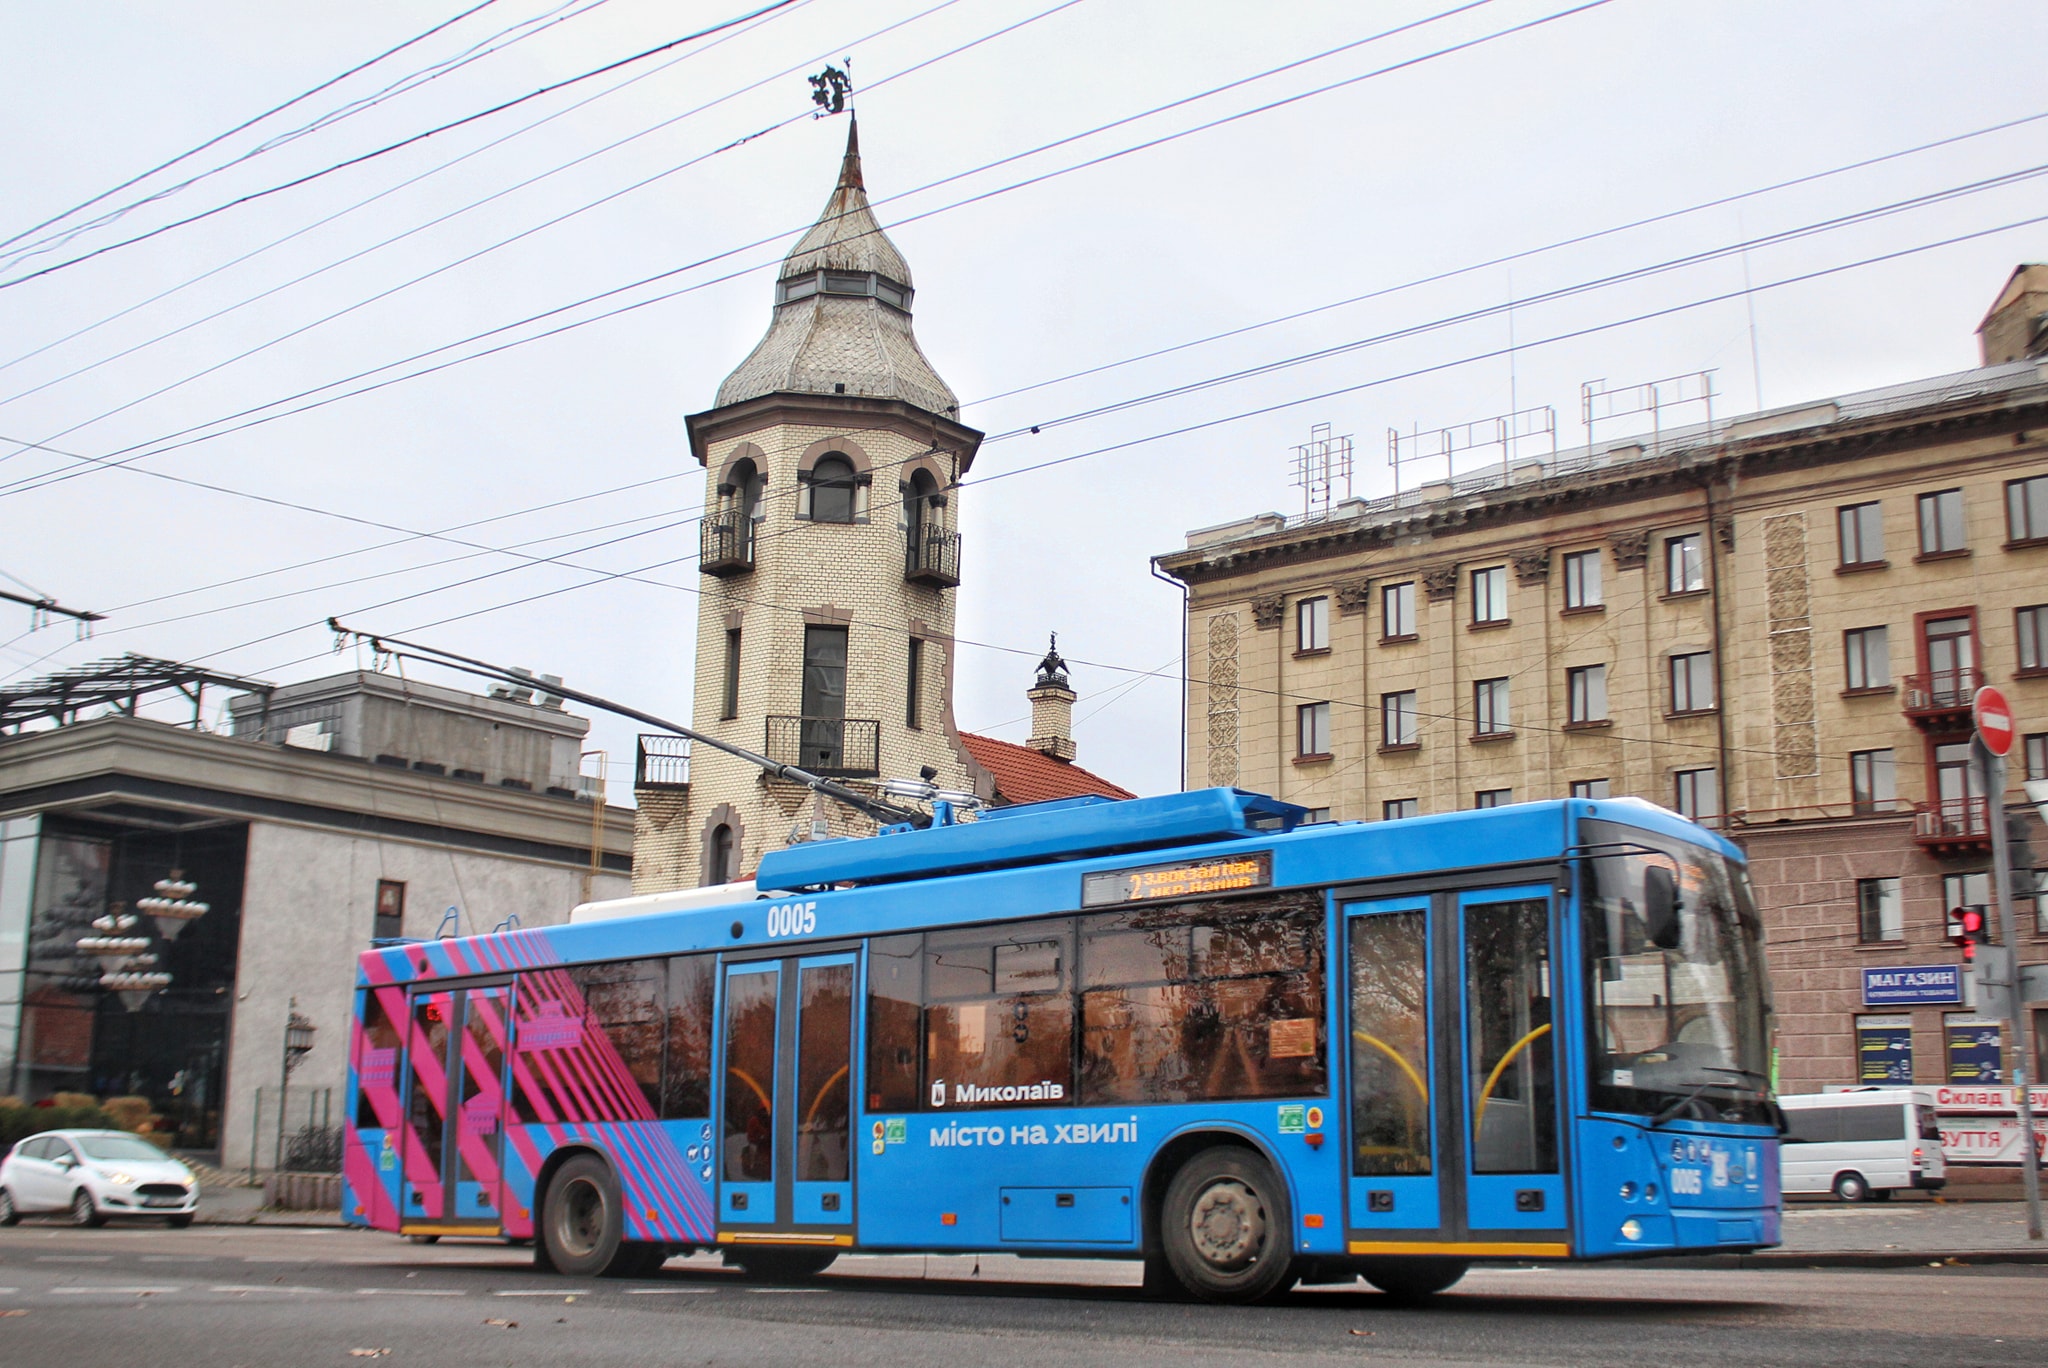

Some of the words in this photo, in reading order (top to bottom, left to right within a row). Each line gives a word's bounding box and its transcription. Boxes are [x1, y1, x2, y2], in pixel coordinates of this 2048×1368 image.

[1129, 874, 1143, 900] 2
[767, 901, 817, 938] 0005
[1867, 971, 1956, 989] МАГАЗИН
[956, 1080, 1064, 1103] Миколаїв
[1937, 1088, 2004, 1107] Склад
[930, 1121, 1005, 1147] місто
[1011, 1126, 1049, 1145] на
[1053, 1115, 1137, 1144] хвилі
